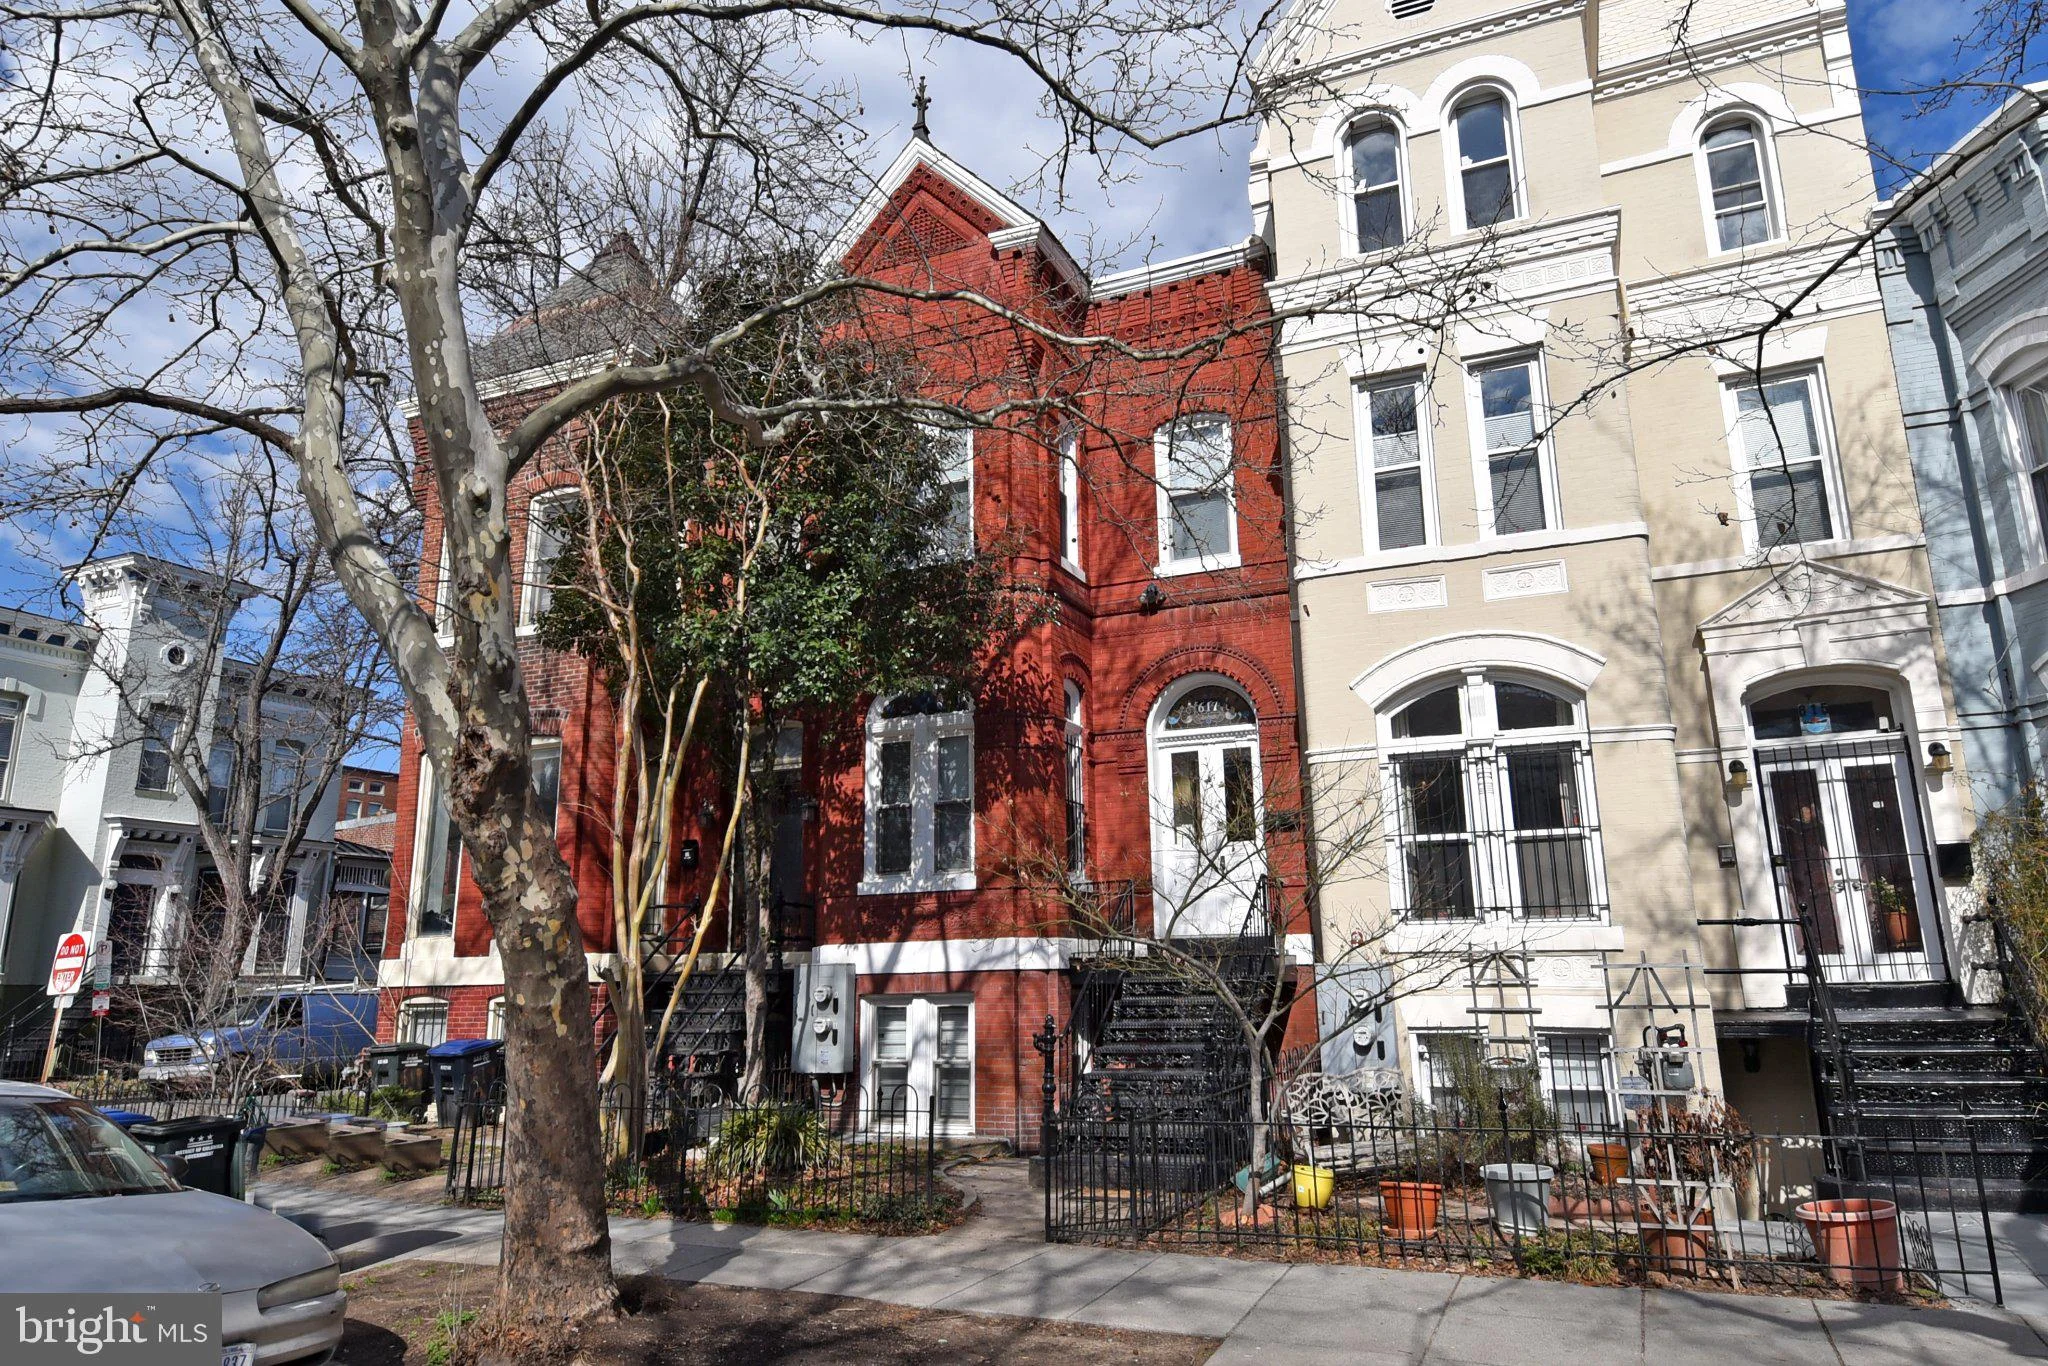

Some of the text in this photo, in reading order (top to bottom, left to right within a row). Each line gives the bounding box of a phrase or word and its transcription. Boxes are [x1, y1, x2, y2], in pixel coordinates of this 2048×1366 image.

[60, 944, 84, 956] DO NOT
[57, 971, 75, 981] ENTER
